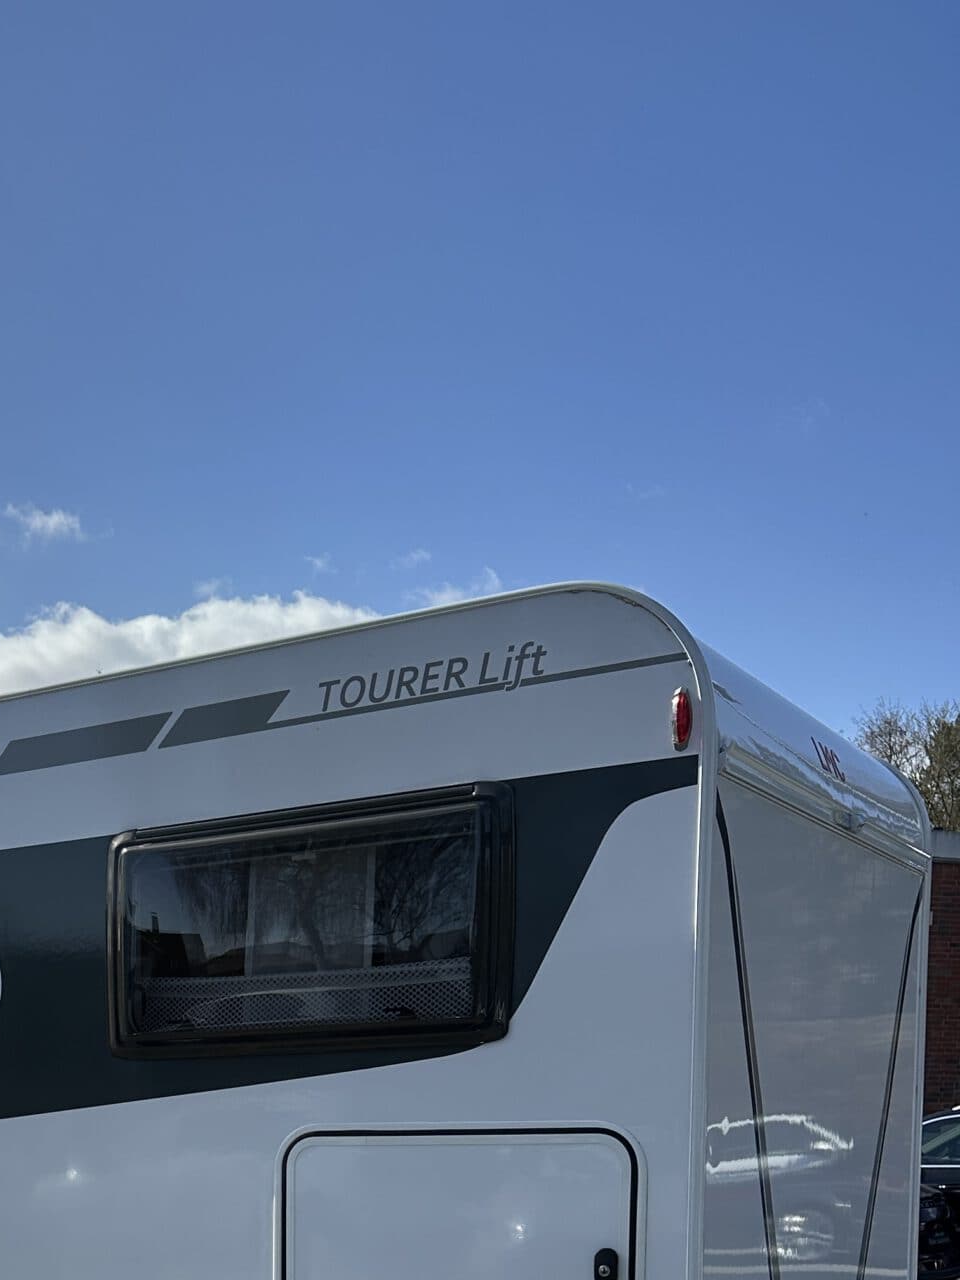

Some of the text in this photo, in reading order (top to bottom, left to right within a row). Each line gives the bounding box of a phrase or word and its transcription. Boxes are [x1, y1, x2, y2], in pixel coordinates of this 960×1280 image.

[319, 641, 547, 712] TOURER Lift
[810, 735, 846, 783] LMC
